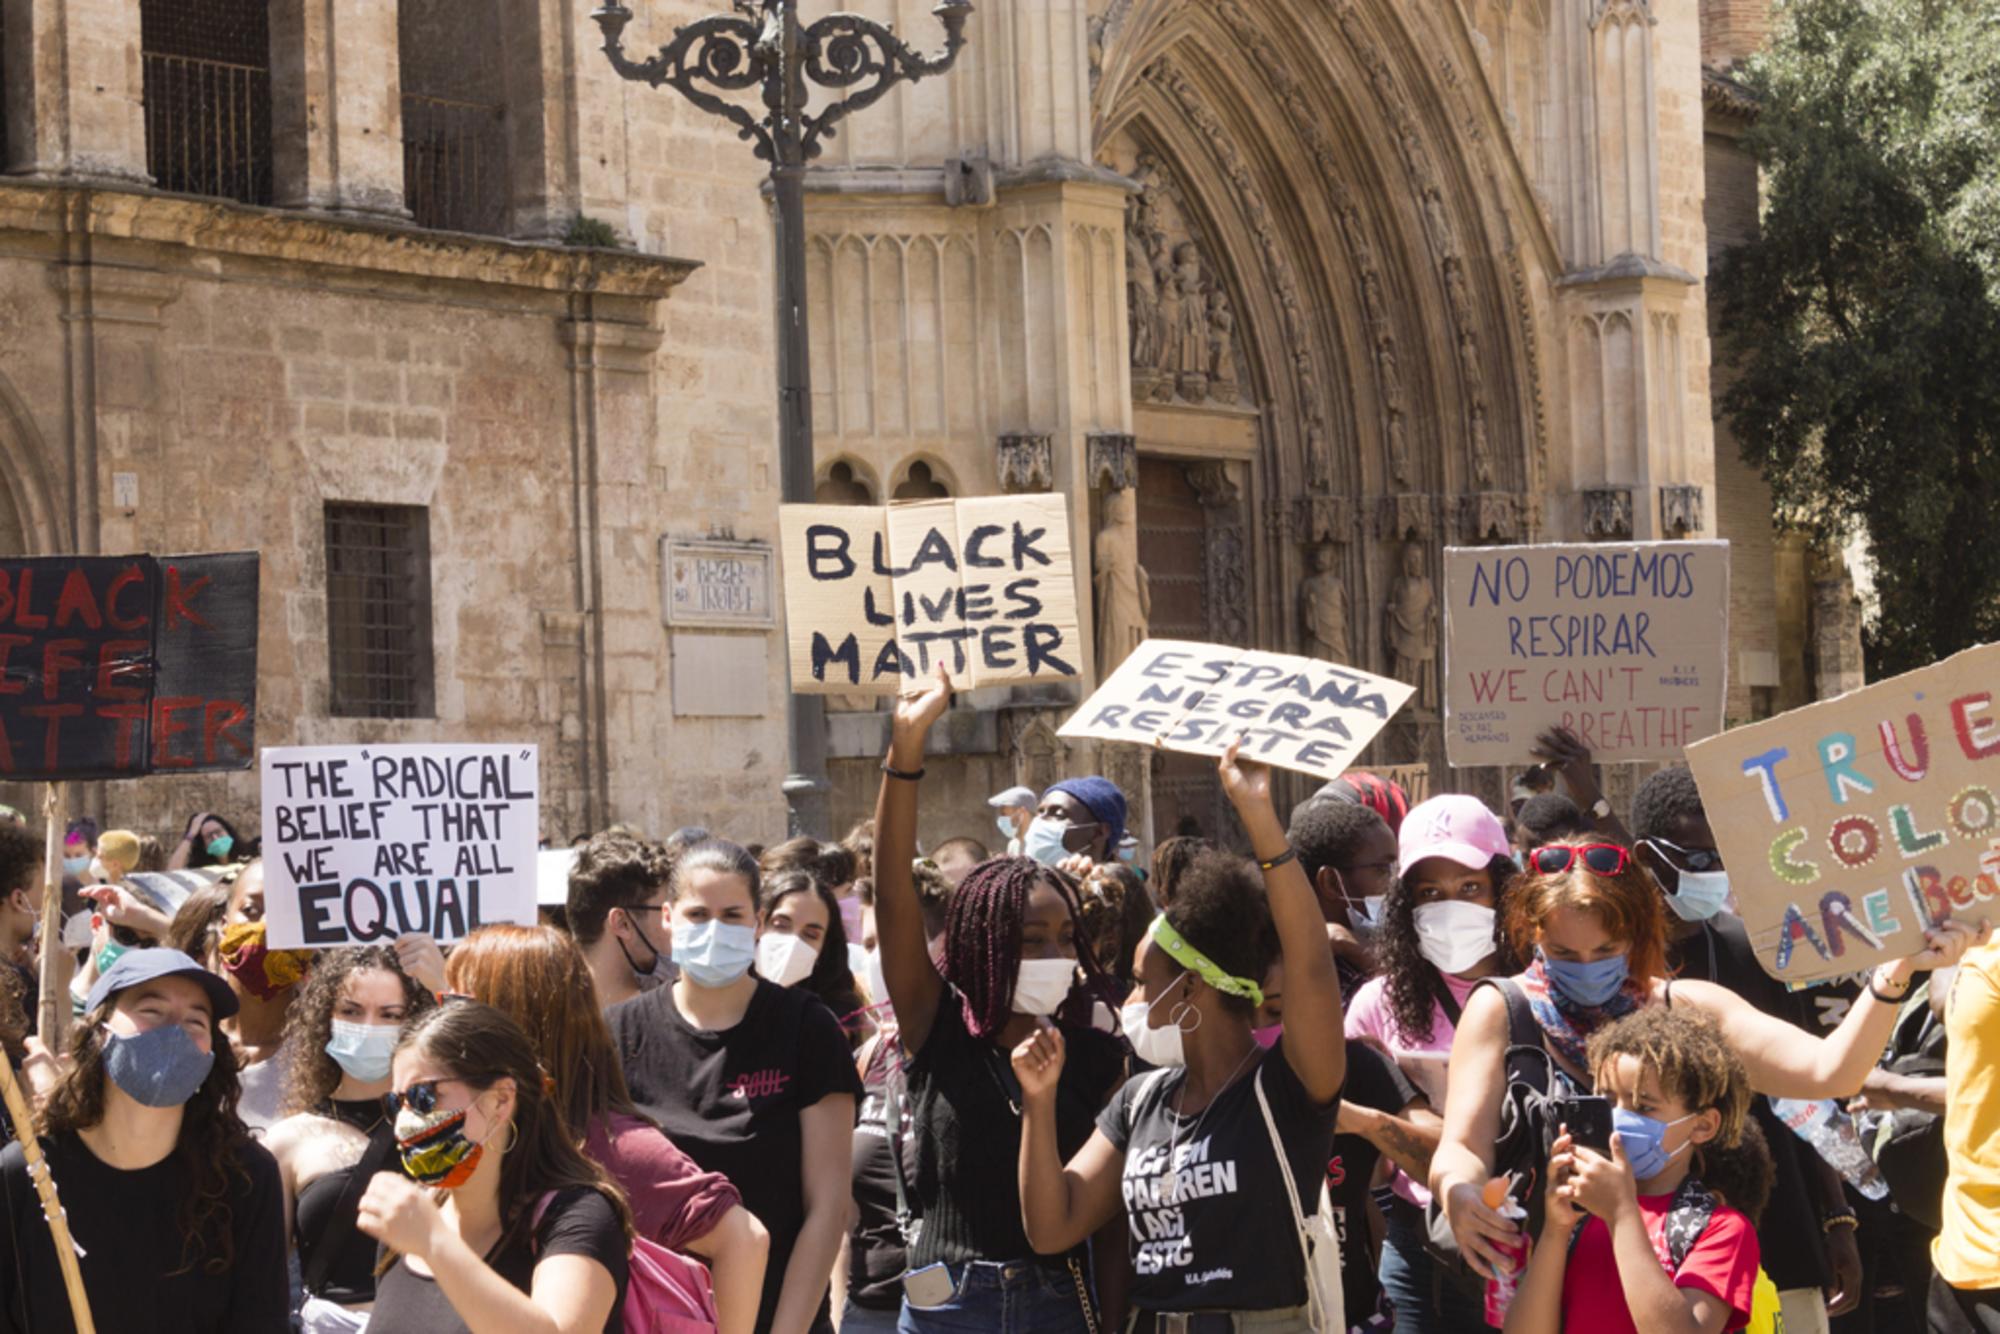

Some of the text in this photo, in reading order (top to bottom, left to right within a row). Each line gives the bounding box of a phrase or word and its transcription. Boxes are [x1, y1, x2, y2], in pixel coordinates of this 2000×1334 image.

[806, 520, 1052, 581] BLACK
[864, 578, 1044, 626] LIVES
[1469, 552, 1695, 607] NO PODEMOS
[811, 621, 1077, 685] MATTER
[1508, 611, 1657, 658] RESPIRAR
[1468, 667, 1644, 704] WE CAN'T
[1137, 683, 1353, 741] NEGRA
[1561, 706, 1700, 751] BREATHE
[272, 750, 534, 800] THE "RADICAL"
[1740, 691, 2000, 824] TRUE
[276, 801, 510, 843] BELIEF THAT
[1768, 784, 2000, 885] COLO
[284, 842, 514, 883] WE ARE ALL
[298, 878, 514, 944] EQUAL
[1776, 887, 1902, 970] ARE
[733, 1070, 784, 1099] SOUL
